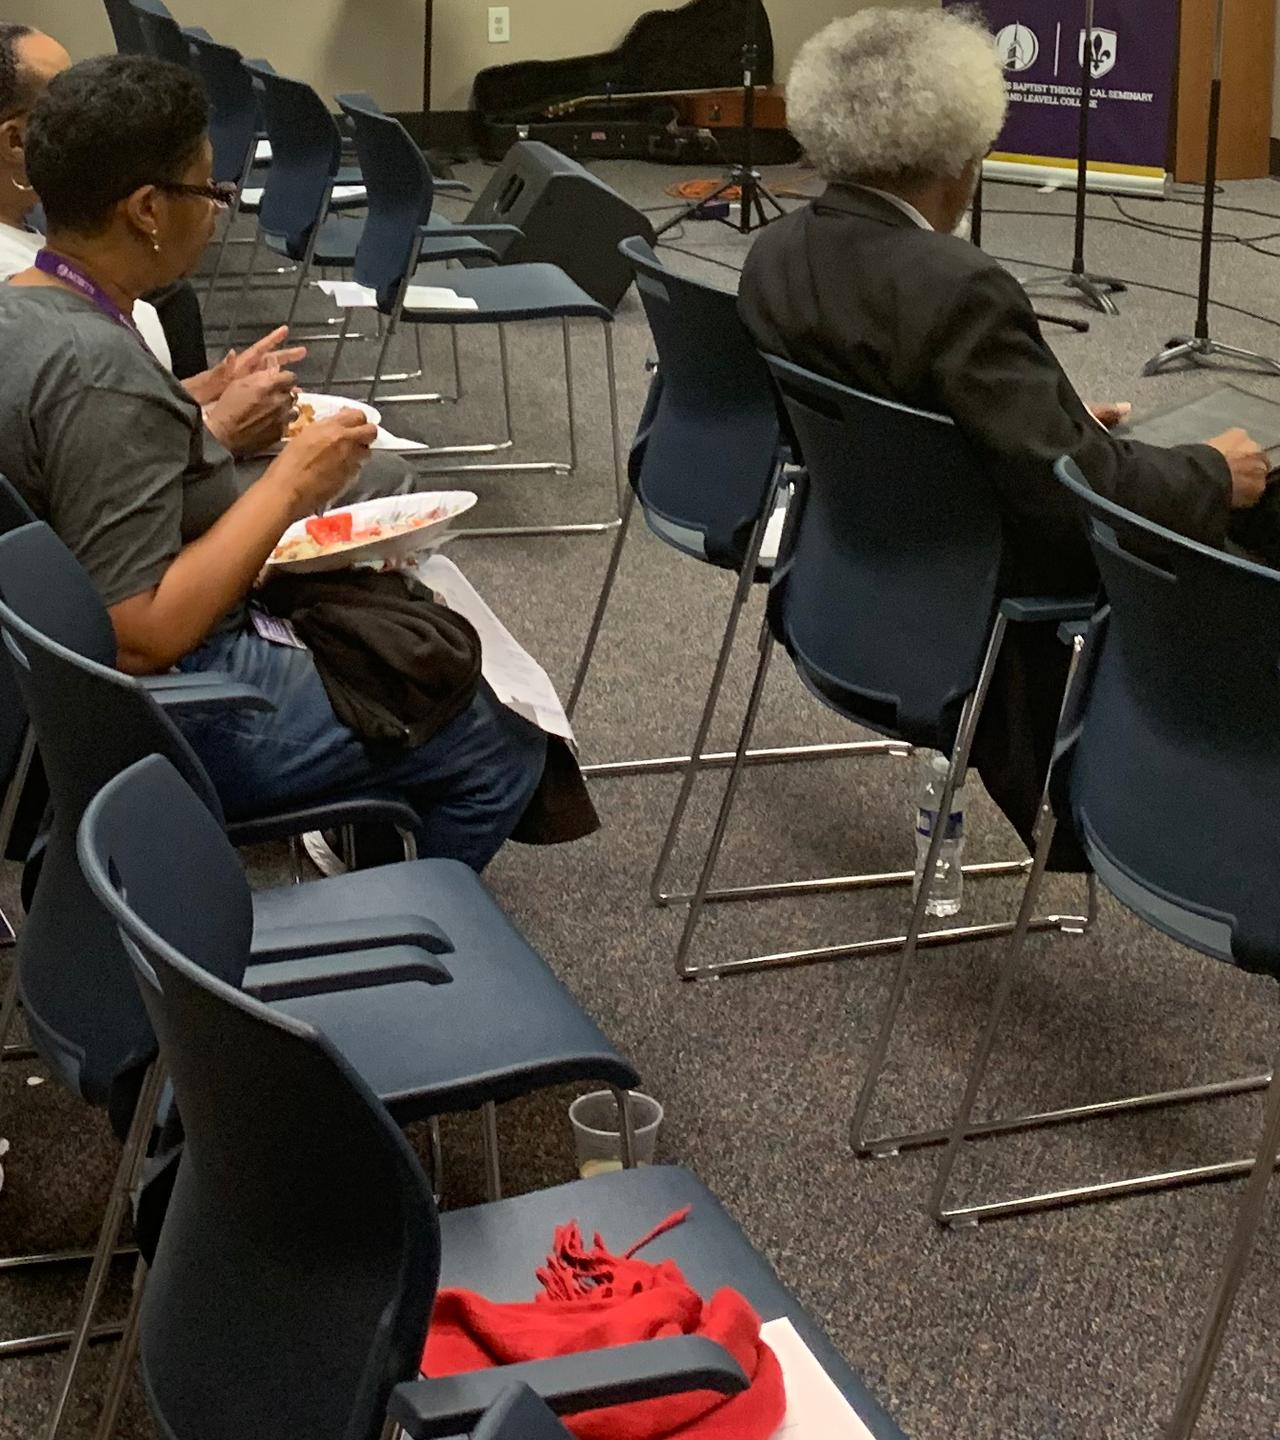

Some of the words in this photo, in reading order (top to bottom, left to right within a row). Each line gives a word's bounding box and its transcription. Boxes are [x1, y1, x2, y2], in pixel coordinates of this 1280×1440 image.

[1012, 82, 1049, 93] BAPTIST
[1049, 84, 1107, 98] THEOLOCAL
[1108, 89, 1154, 103] SEMINARY
[1023, 93, 1059, 105] LEAVELL
[1060, 96, 1098, 109] COLLE
